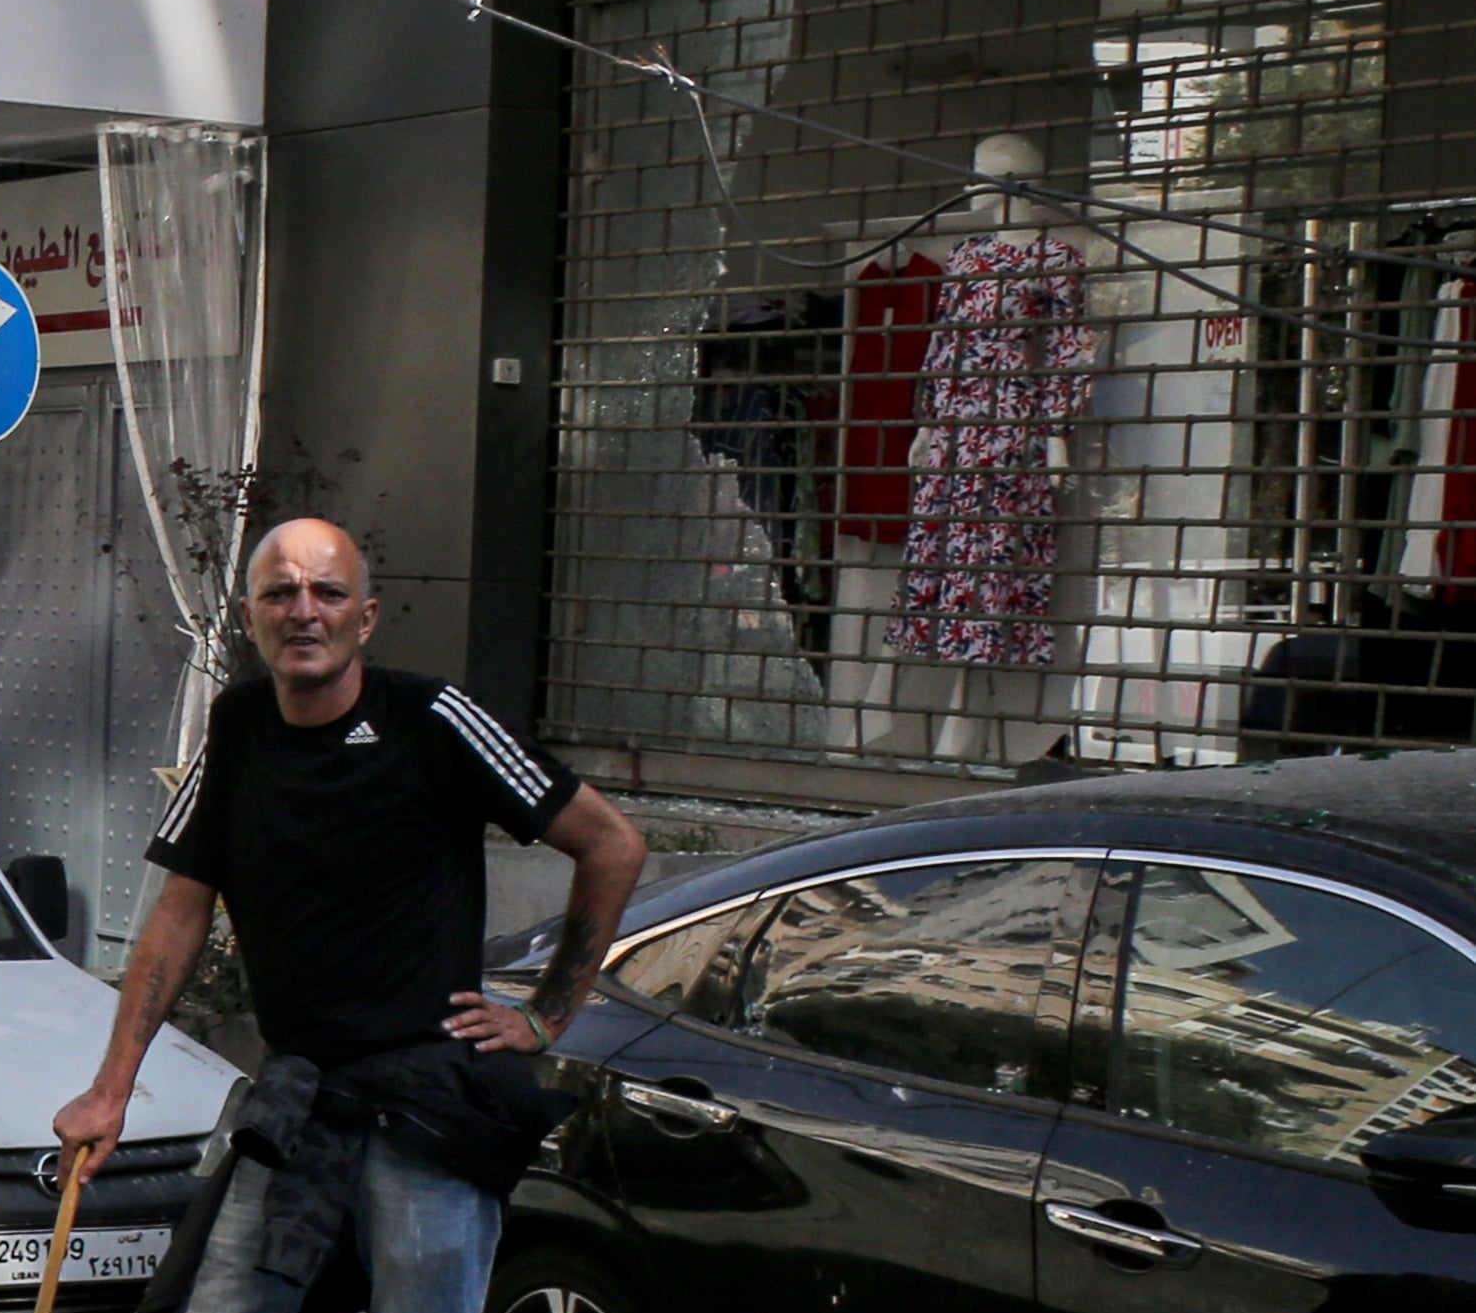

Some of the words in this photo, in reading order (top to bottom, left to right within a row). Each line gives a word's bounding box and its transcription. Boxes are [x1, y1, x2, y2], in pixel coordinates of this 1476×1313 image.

[1205, 315, 1243, 349] OPEN
[345, 735, 379, 745] adidas
[89, 1254, 157, 1278] ٢٤٩١٦٩
[11, 1271, 40, 1281] LIBAN
